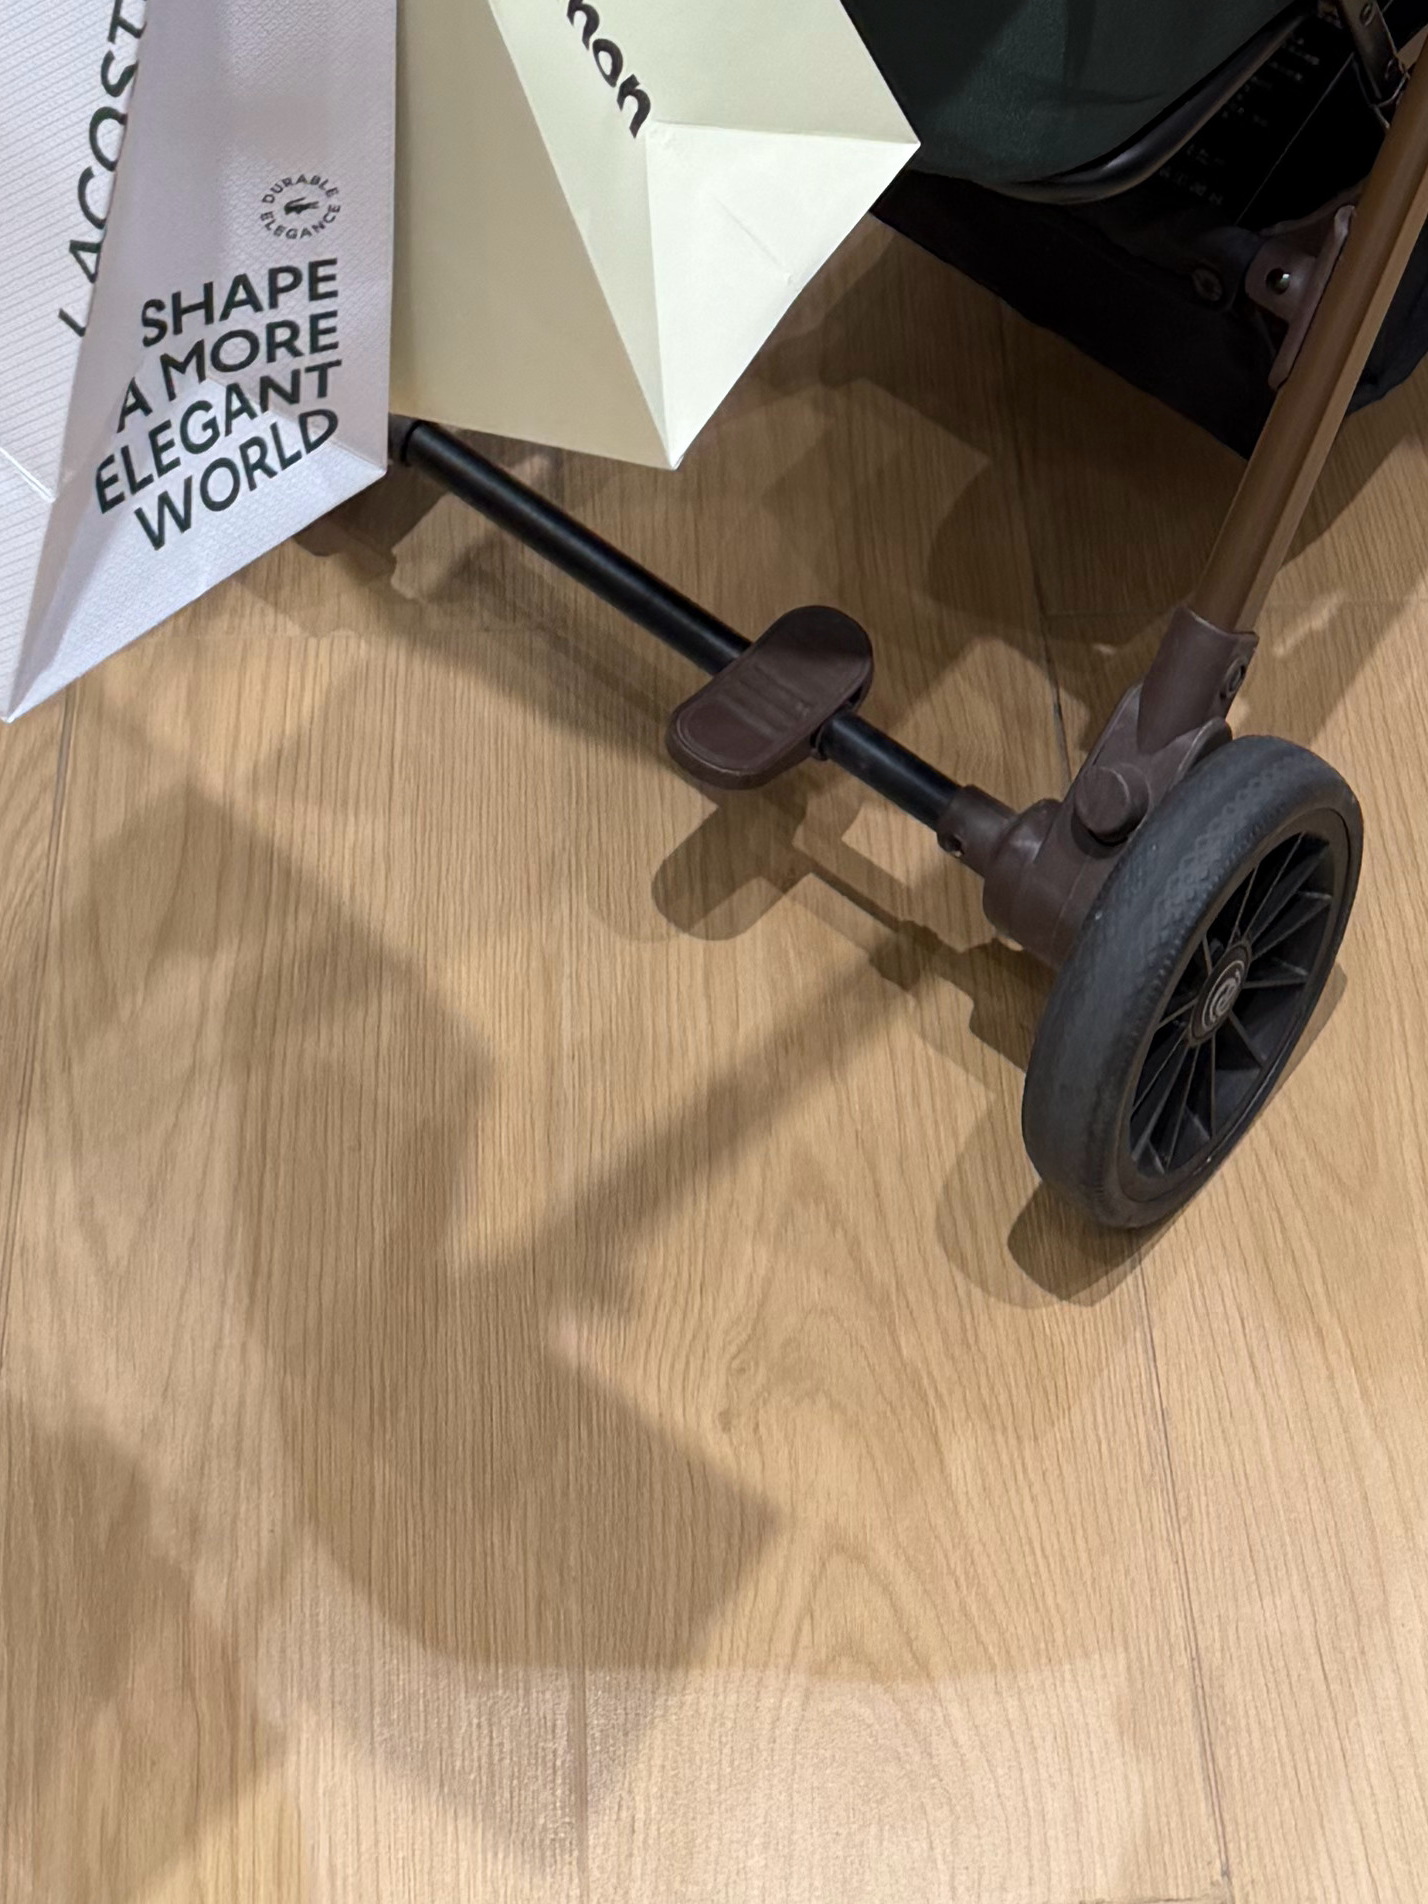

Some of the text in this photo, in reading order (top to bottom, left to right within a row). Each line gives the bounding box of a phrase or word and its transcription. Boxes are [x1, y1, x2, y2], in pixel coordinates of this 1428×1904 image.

[259, 205, 341, 240] ELEGANCE
[261, 174, 340, 204] DURABLE
[141, 258, 339, 348] SHAPE
[116, 310, 340, 434] A MORE
[95, 359, 343, 515] ELEGANT
[134, 409, 339, 552] WORLD
